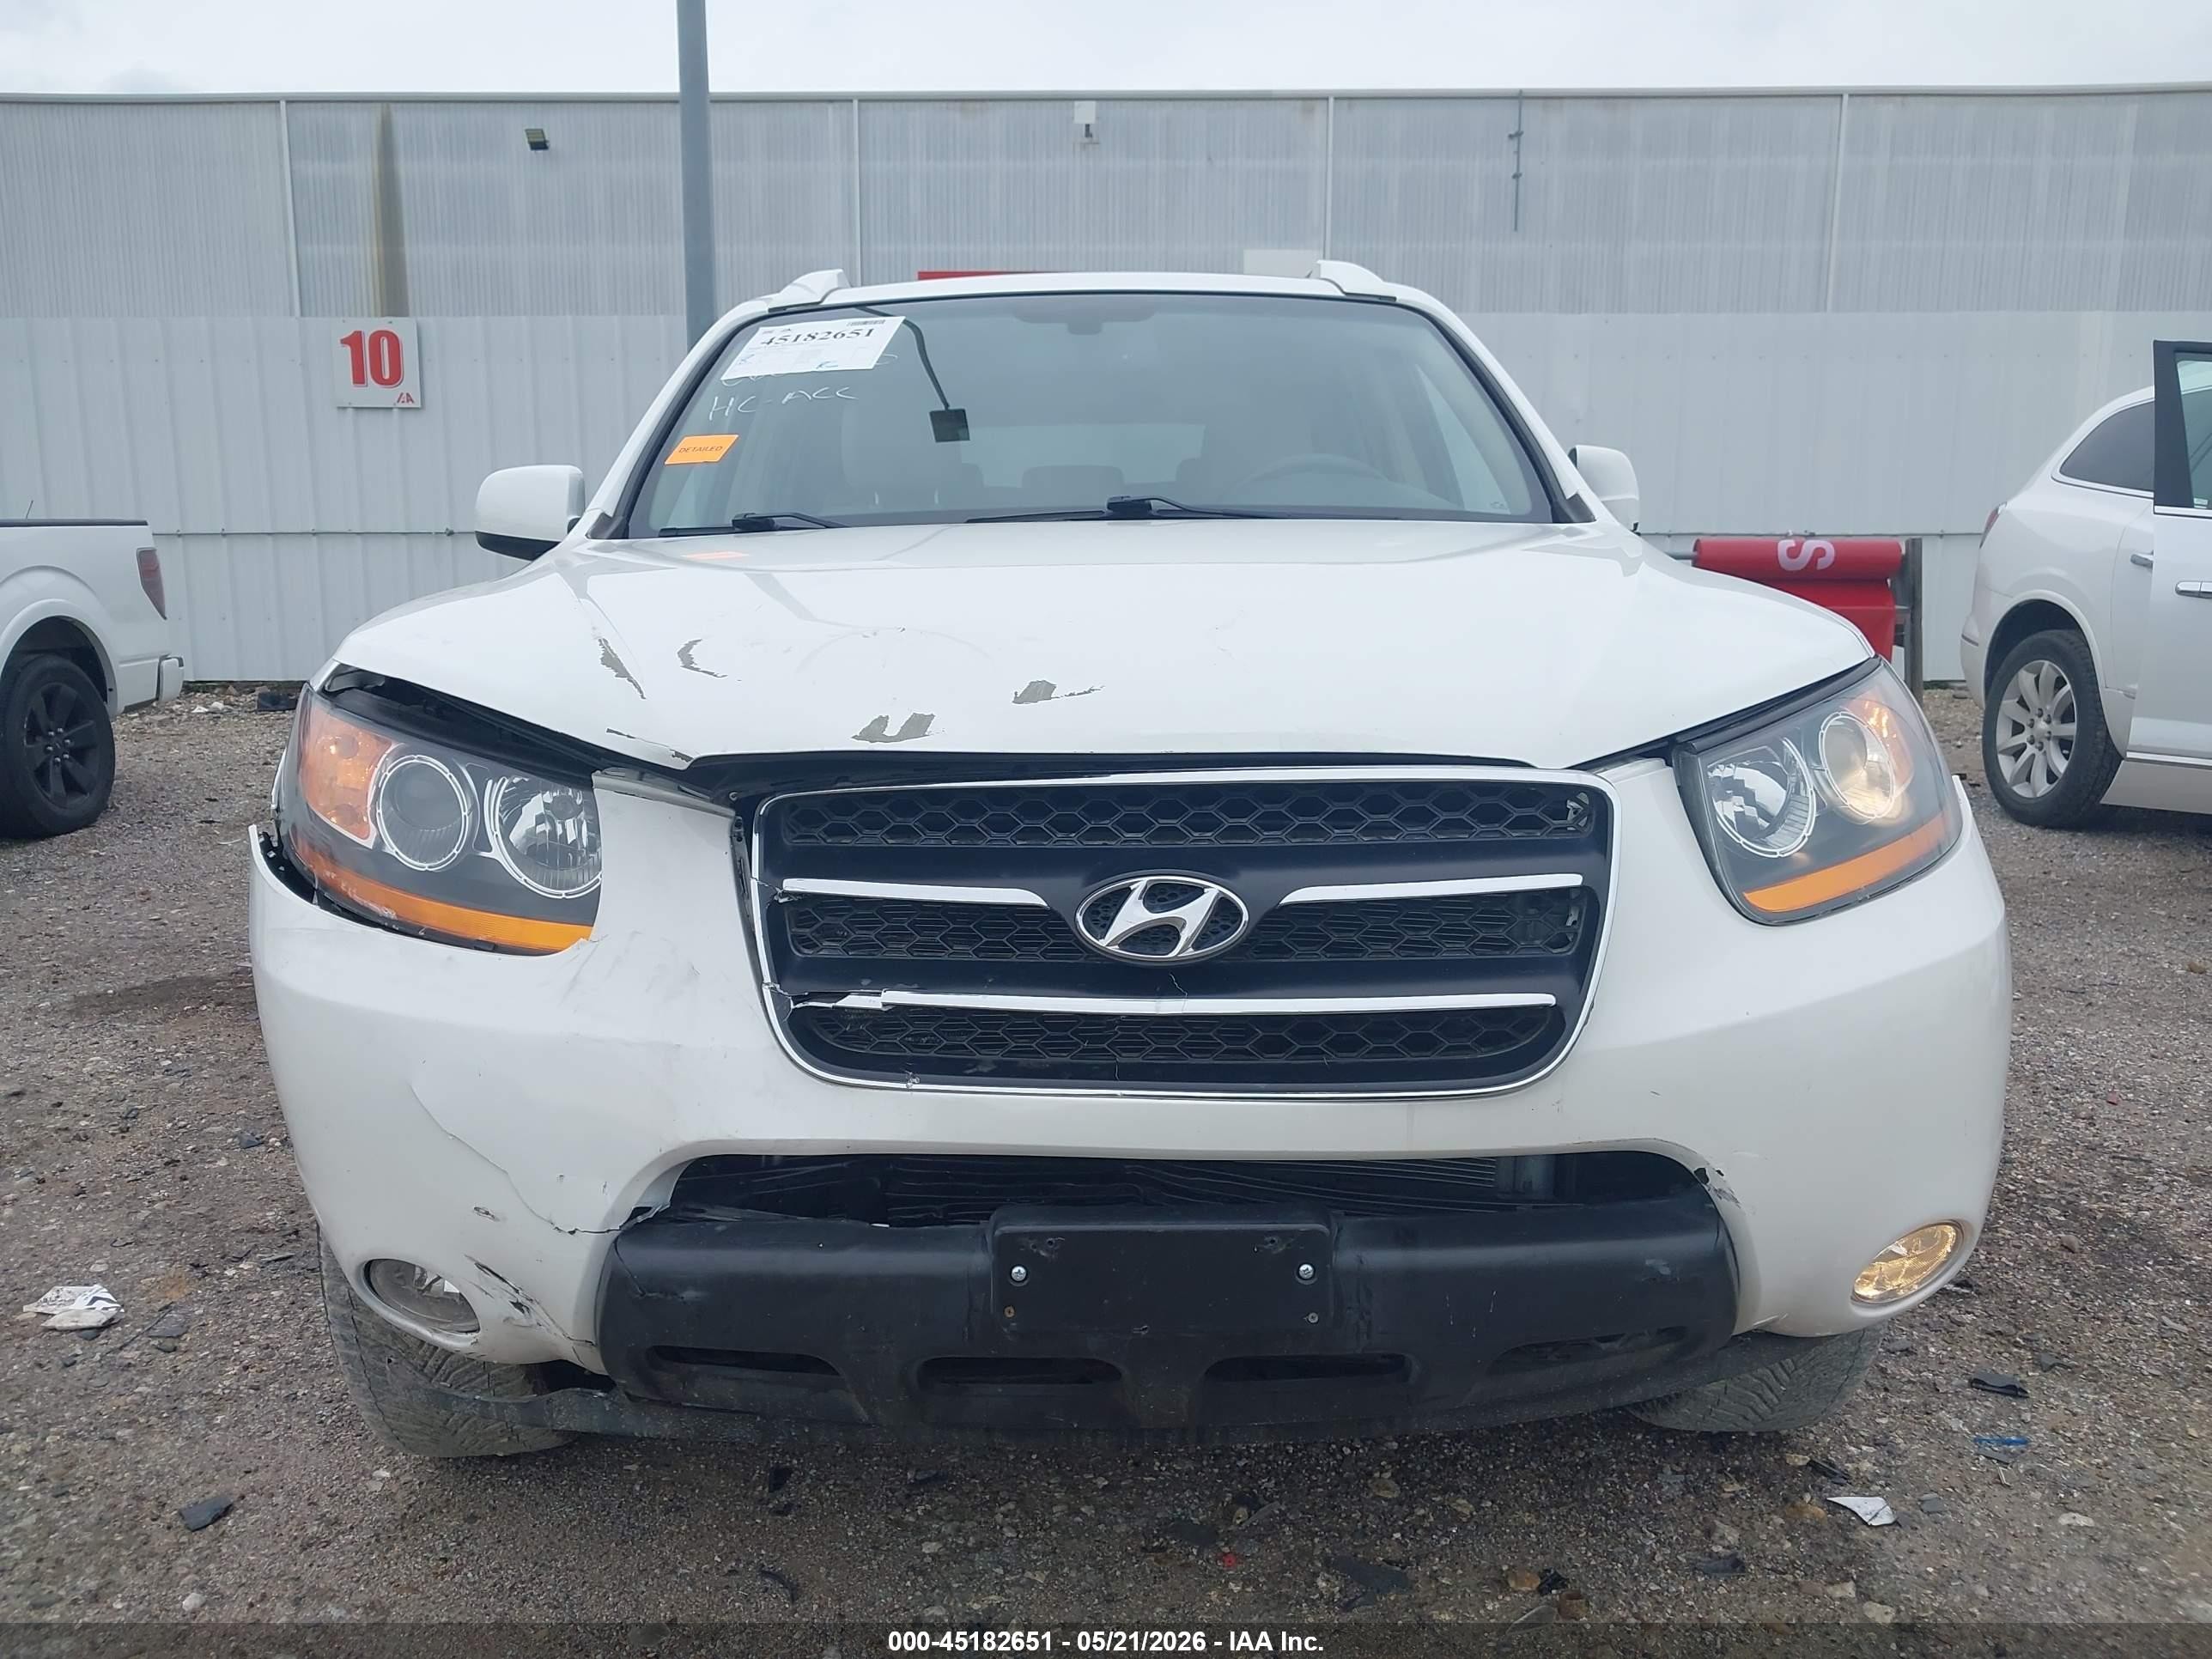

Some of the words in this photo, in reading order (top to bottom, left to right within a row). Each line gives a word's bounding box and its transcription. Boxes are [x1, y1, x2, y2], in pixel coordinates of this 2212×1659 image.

[761, 328, 875, 345] 45182651
[340, 330, 404, 388] 10
[1778, 539, 1835, 571] S
